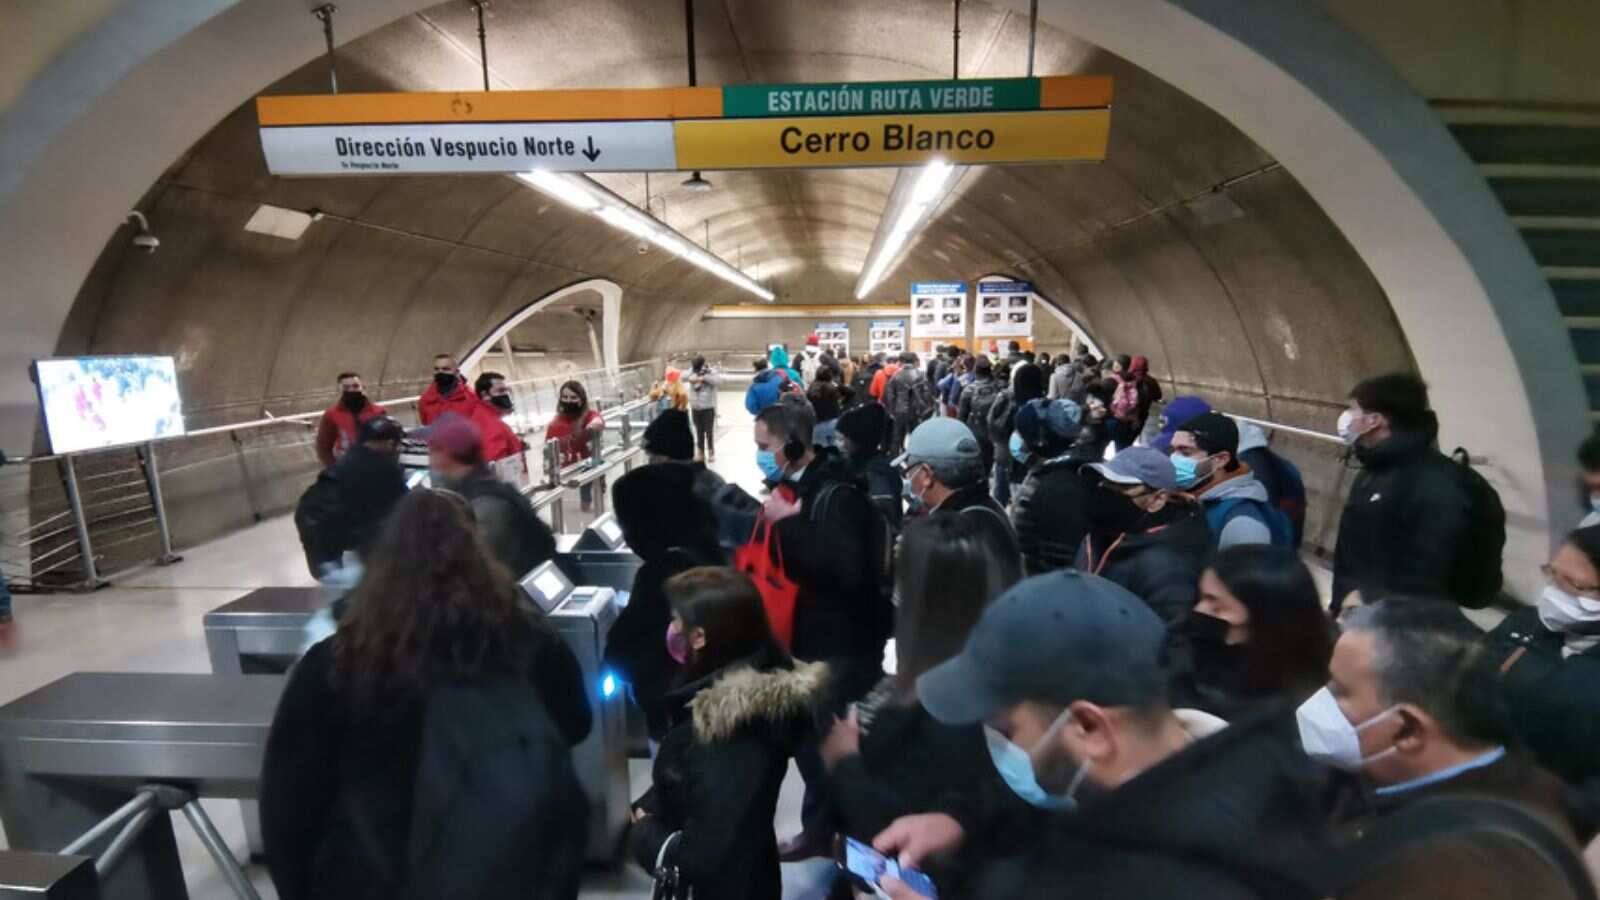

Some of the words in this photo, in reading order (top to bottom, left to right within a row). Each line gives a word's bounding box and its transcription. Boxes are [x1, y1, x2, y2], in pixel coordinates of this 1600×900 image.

[767, 86, 863, 112] ESTACIÓN
[871, 88, 921, 109] RUTA
[929, 87, 994, 108] VERDE
[335, 136, 426, 158] Dirección
[430, 136, 518, 160] Vespucio
[524, 136, 575, 156] Norte
[780, 126, 870, 154] Cerro
[883, 123, 994, 151] Blanco
